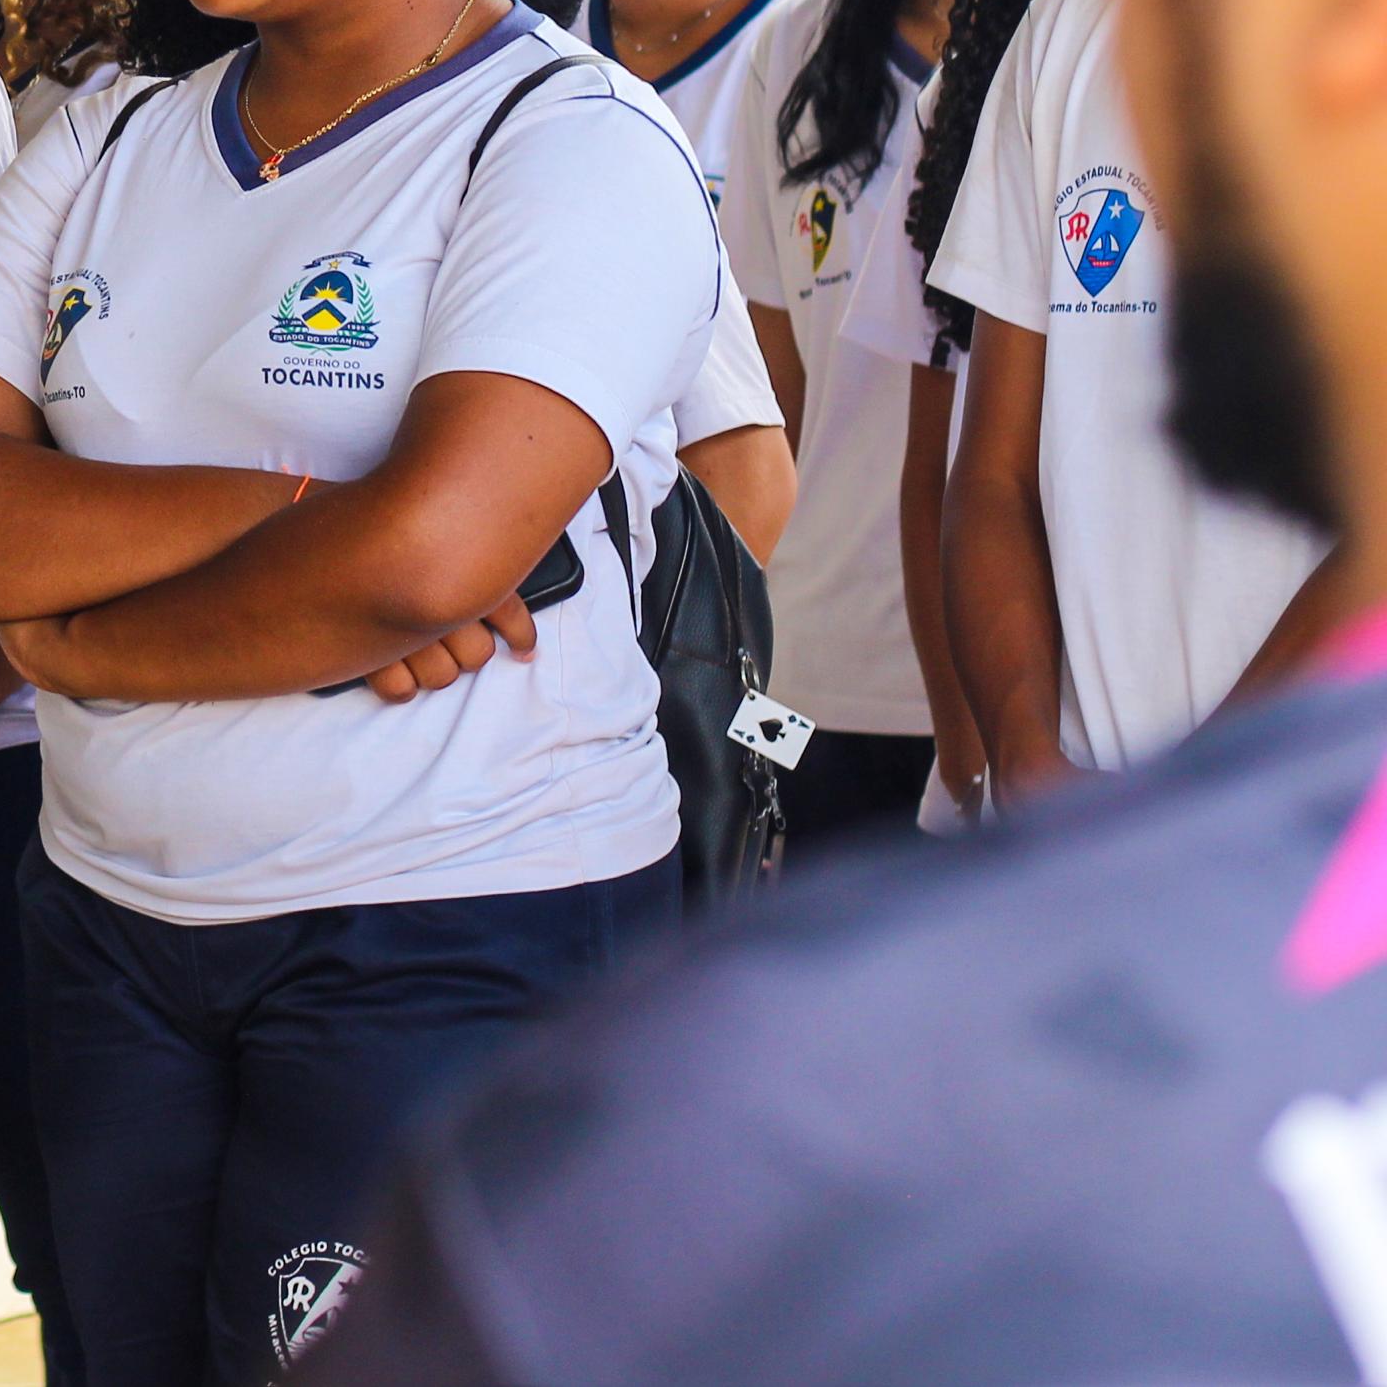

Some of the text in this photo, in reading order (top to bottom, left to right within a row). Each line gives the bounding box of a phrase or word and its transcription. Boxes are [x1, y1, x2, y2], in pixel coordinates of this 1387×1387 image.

[1091, 300, 1158, 314] Tocantins-TO
[283, 356, 360, 369] GOVERNO DO
[262, 368, 385, 389] TOCANTINS
[267, 1241, 327, 1276] COLEGIO
